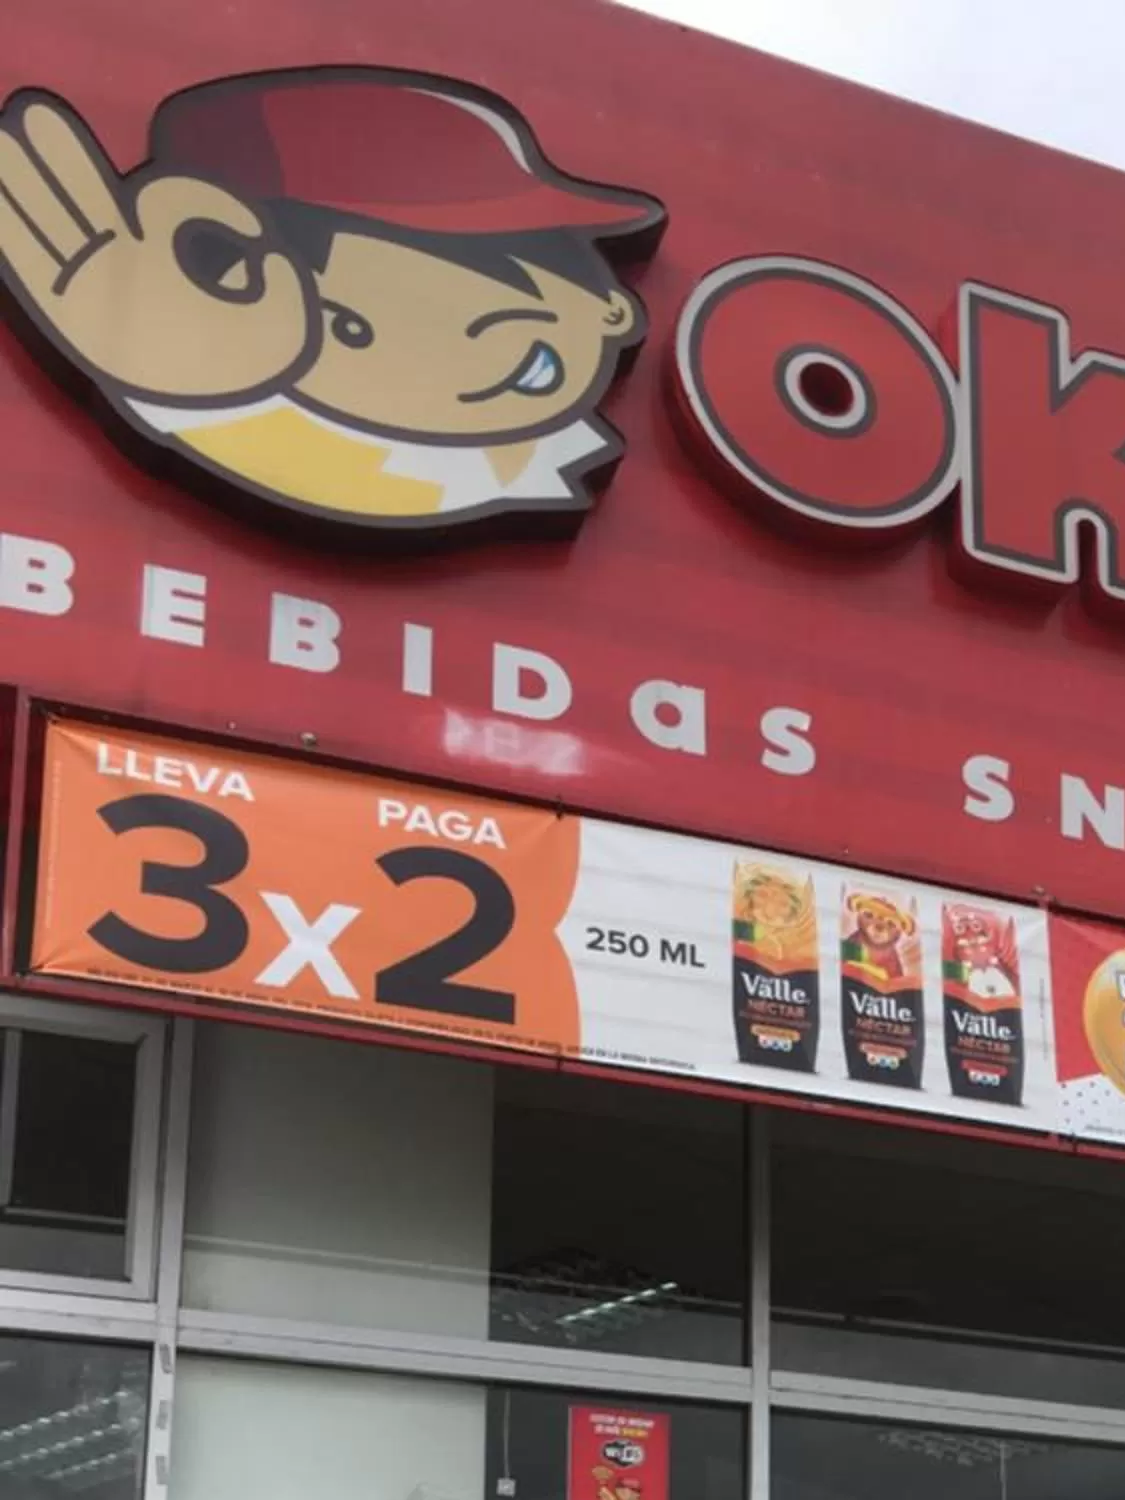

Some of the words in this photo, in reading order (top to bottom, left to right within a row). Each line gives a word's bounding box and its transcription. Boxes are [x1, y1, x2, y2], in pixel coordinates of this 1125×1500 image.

[97, 742, 255, 801] LLEVA
[377, 797, 507, 849] PAGA
[586, 927, 649, 958] 250
[660, 938, 706, 968] ML
